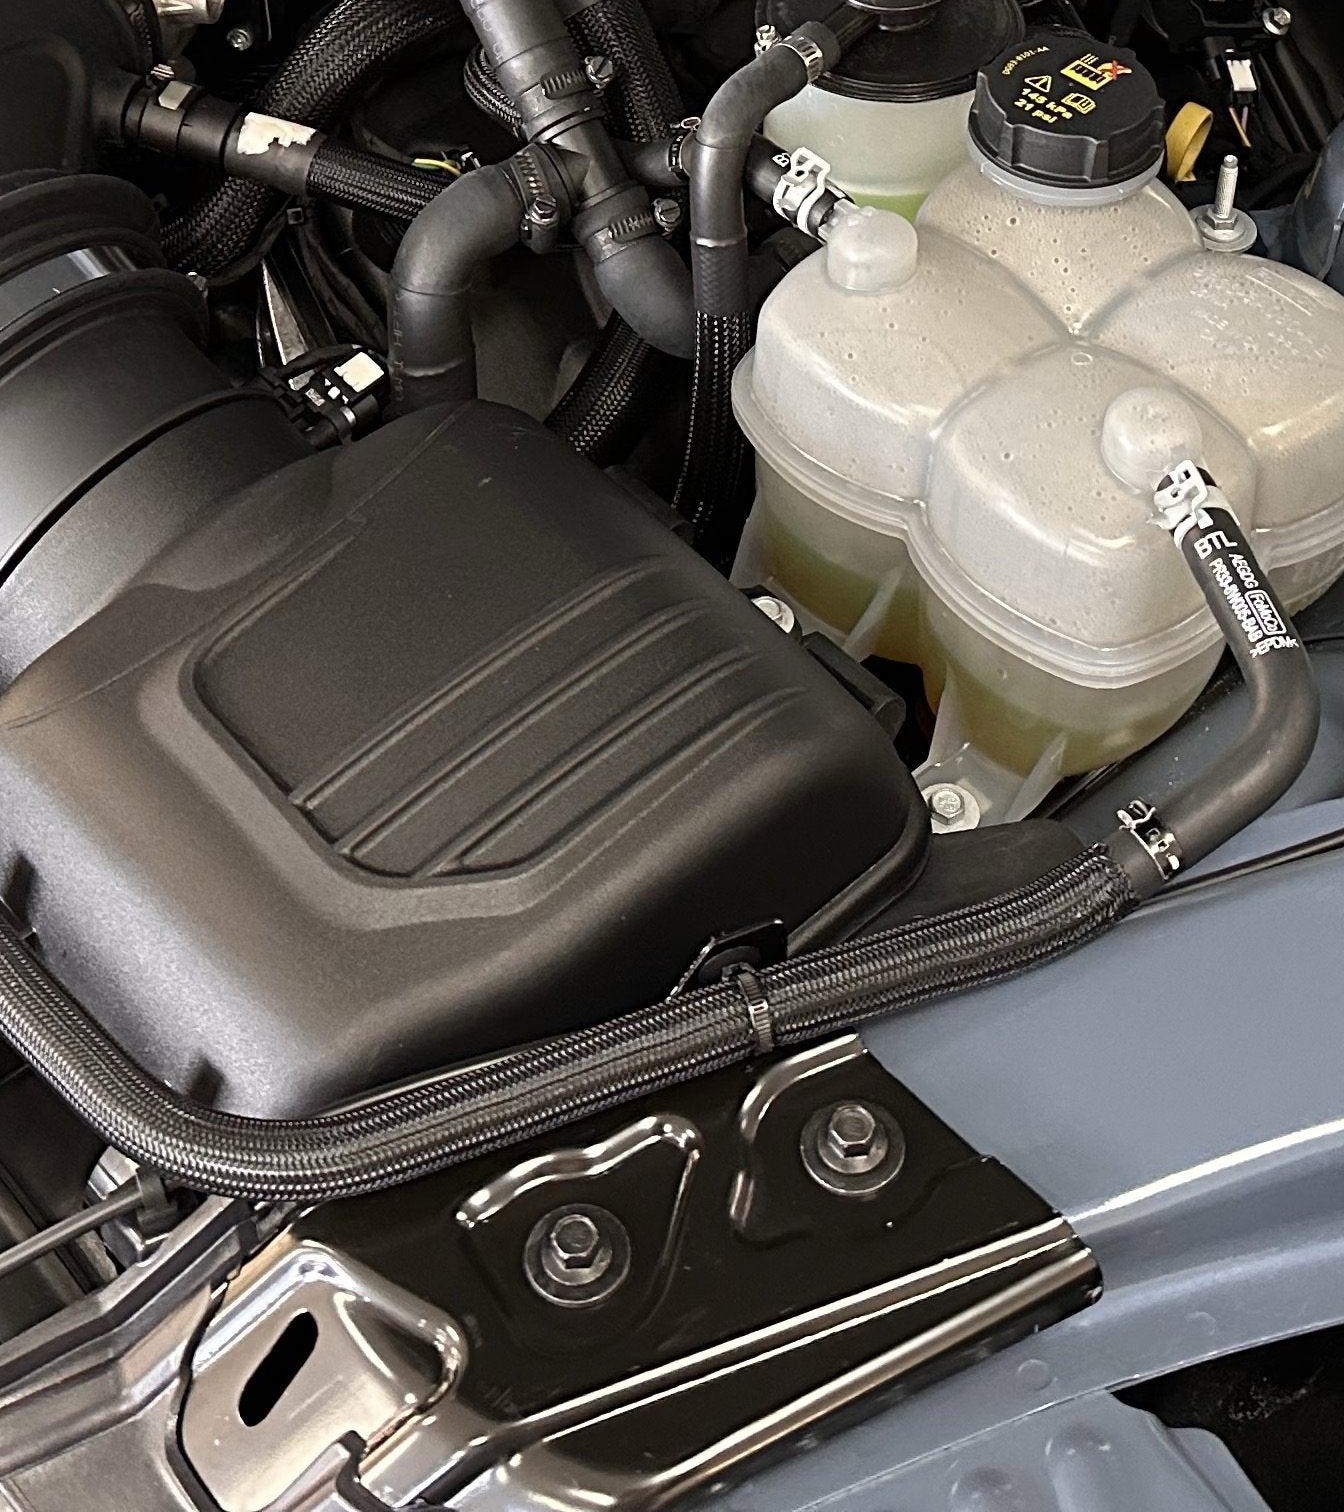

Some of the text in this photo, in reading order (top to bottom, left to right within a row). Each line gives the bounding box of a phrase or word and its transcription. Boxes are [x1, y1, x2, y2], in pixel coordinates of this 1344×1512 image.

[1014, 98, 1058, 124] 21 psi
[1021, 87, 1073, 120] 145 kPa
[771, 151, 791, 168] B
[1193, 530, 1238, 560] BTL
[1248, 592, 1279, 633] FoMoCo
